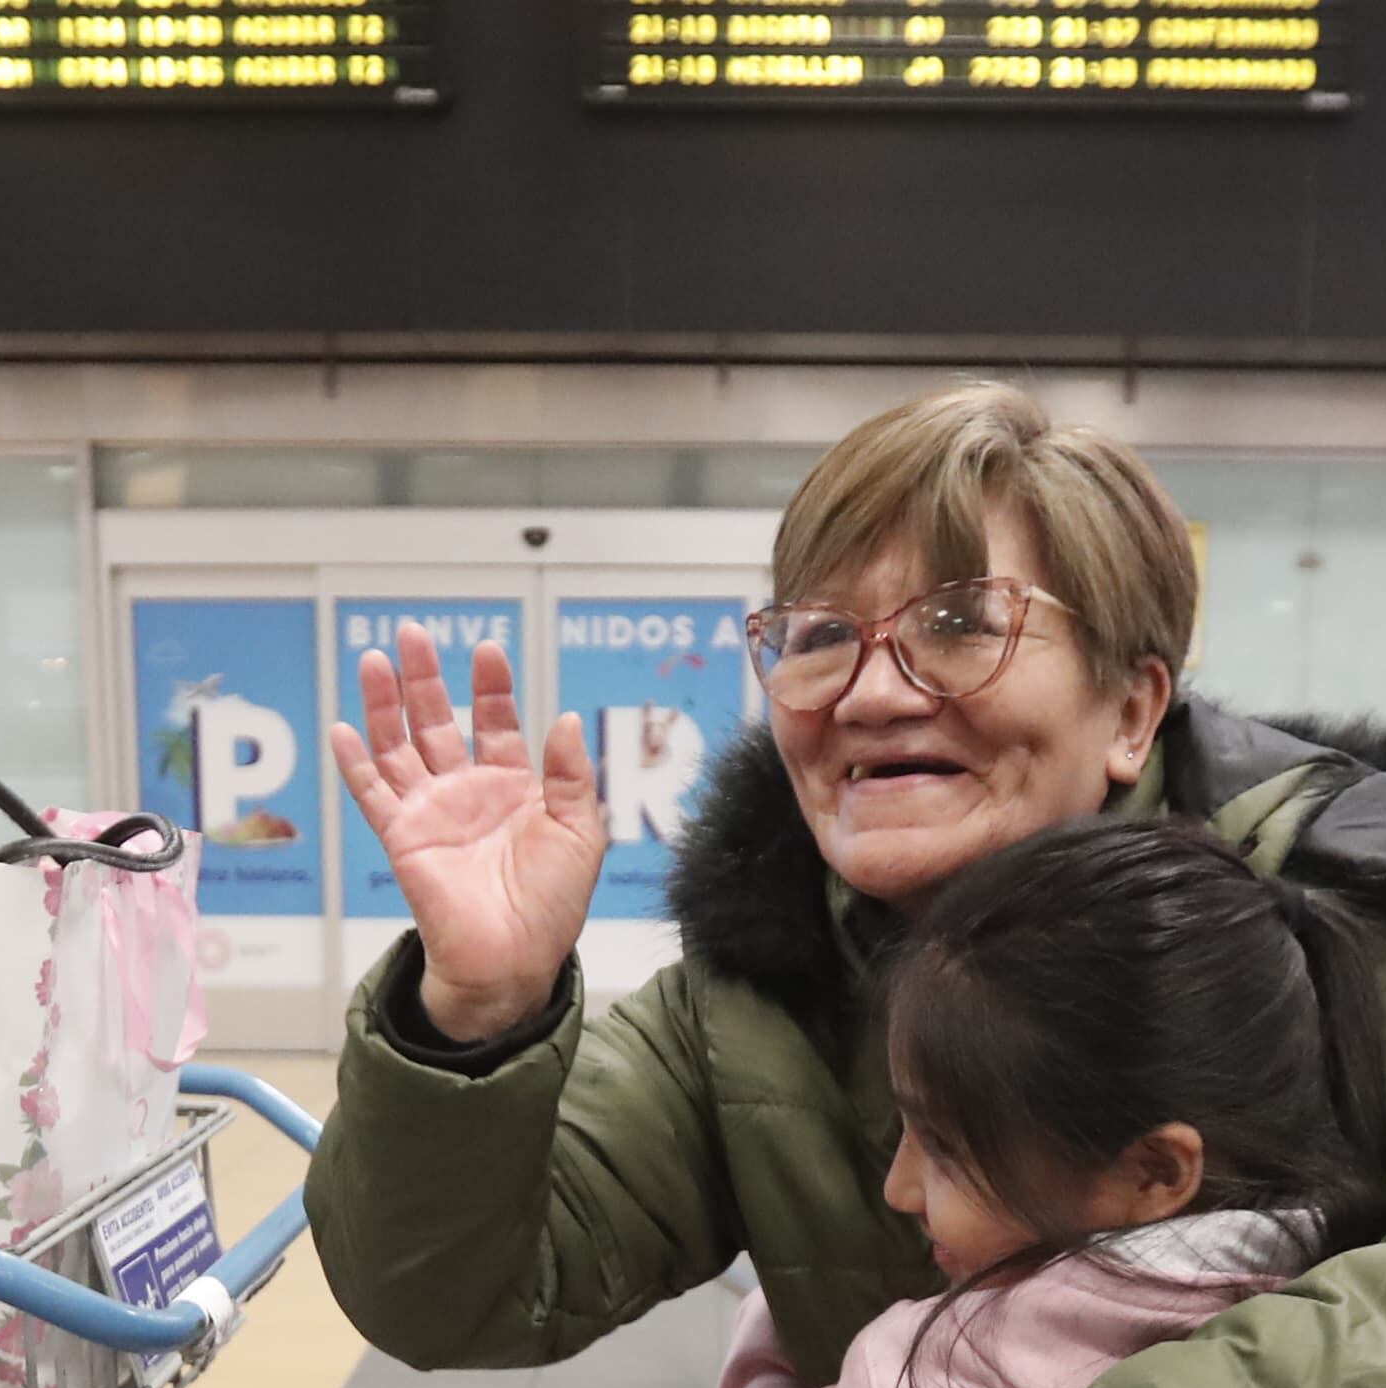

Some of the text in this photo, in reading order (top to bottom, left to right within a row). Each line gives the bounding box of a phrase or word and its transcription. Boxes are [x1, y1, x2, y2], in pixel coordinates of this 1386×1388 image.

[347, 615, 741, 648] BINVE NIDOS A
[193, 698, 297, 845] P
